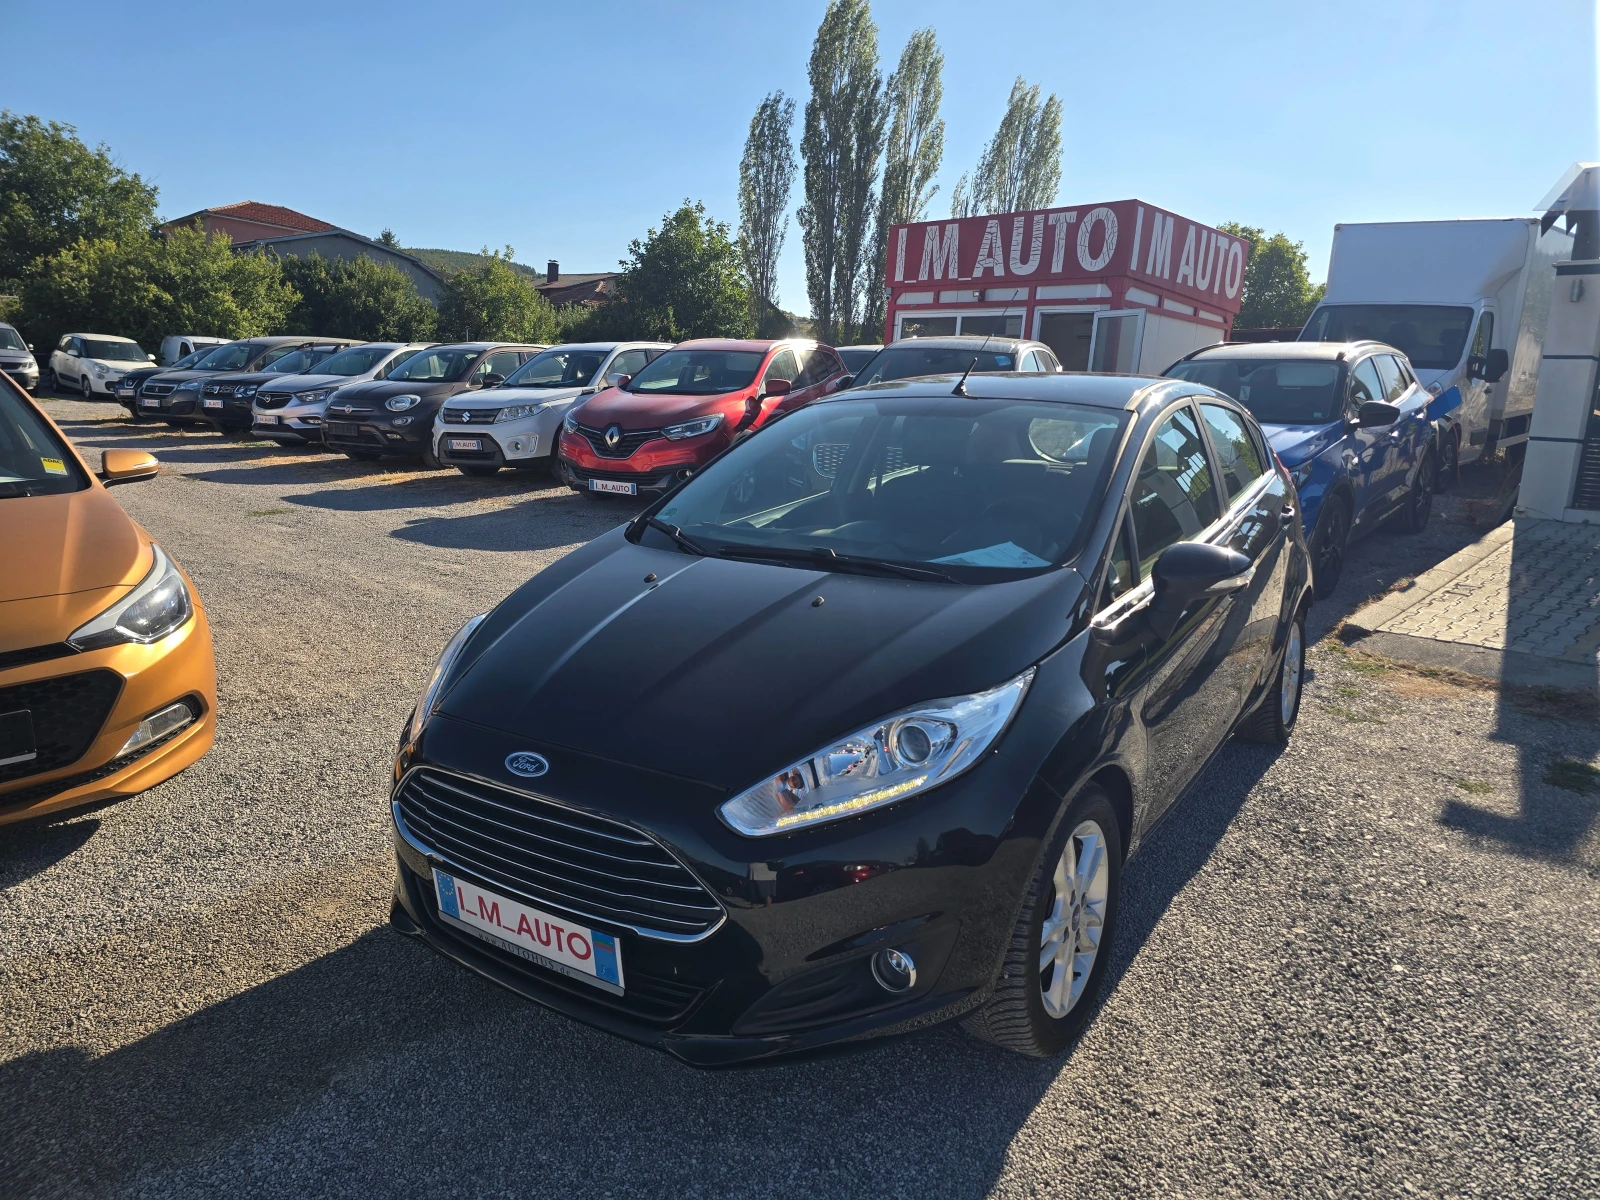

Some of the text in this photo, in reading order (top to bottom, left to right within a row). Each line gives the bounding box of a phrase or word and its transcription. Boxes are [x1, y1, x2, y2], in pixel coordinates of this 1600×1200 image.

[1130, 206, 1243, 300] I M AUTO
[595, 481, 630, 493] I_M_AUTO
[512, 755, 540, 772] Ford
[457, 886, 592, 961] I_M_AUTO
[478, 932, 572, 976] www.AUTOHUS.de
